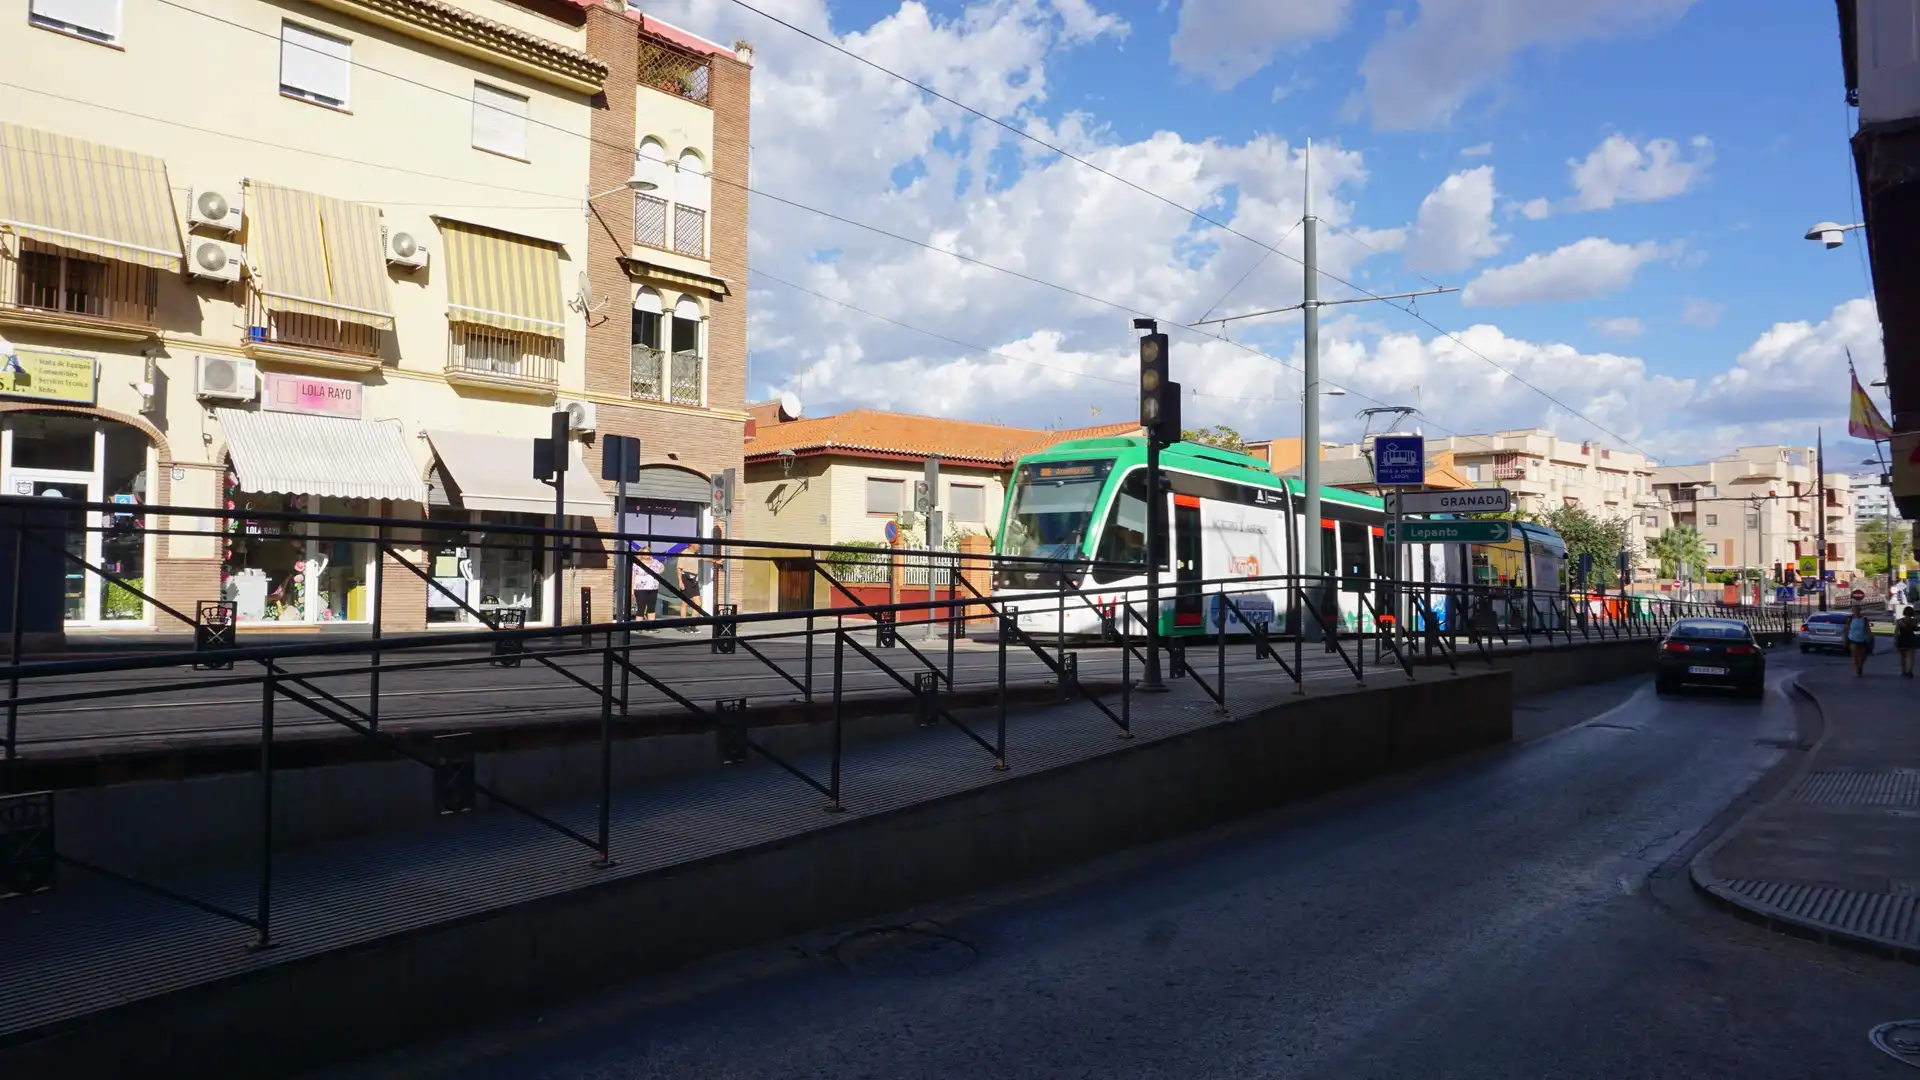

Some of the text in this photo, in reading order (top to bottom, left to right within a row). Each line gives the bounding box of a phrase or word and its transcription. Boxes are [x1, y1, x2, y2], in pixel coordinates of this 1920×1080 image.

[38, 367, 78, 378] Consumibles
[38, 377, 64, 386] Servicio
[302, 383, 352, 400] LOLA RAYO
[1440, 495, 1503, 507] GRANADA
[245, 526, 280, 535] LOLA RAYO
[1410, 527, 1459, 538] Lepanto
